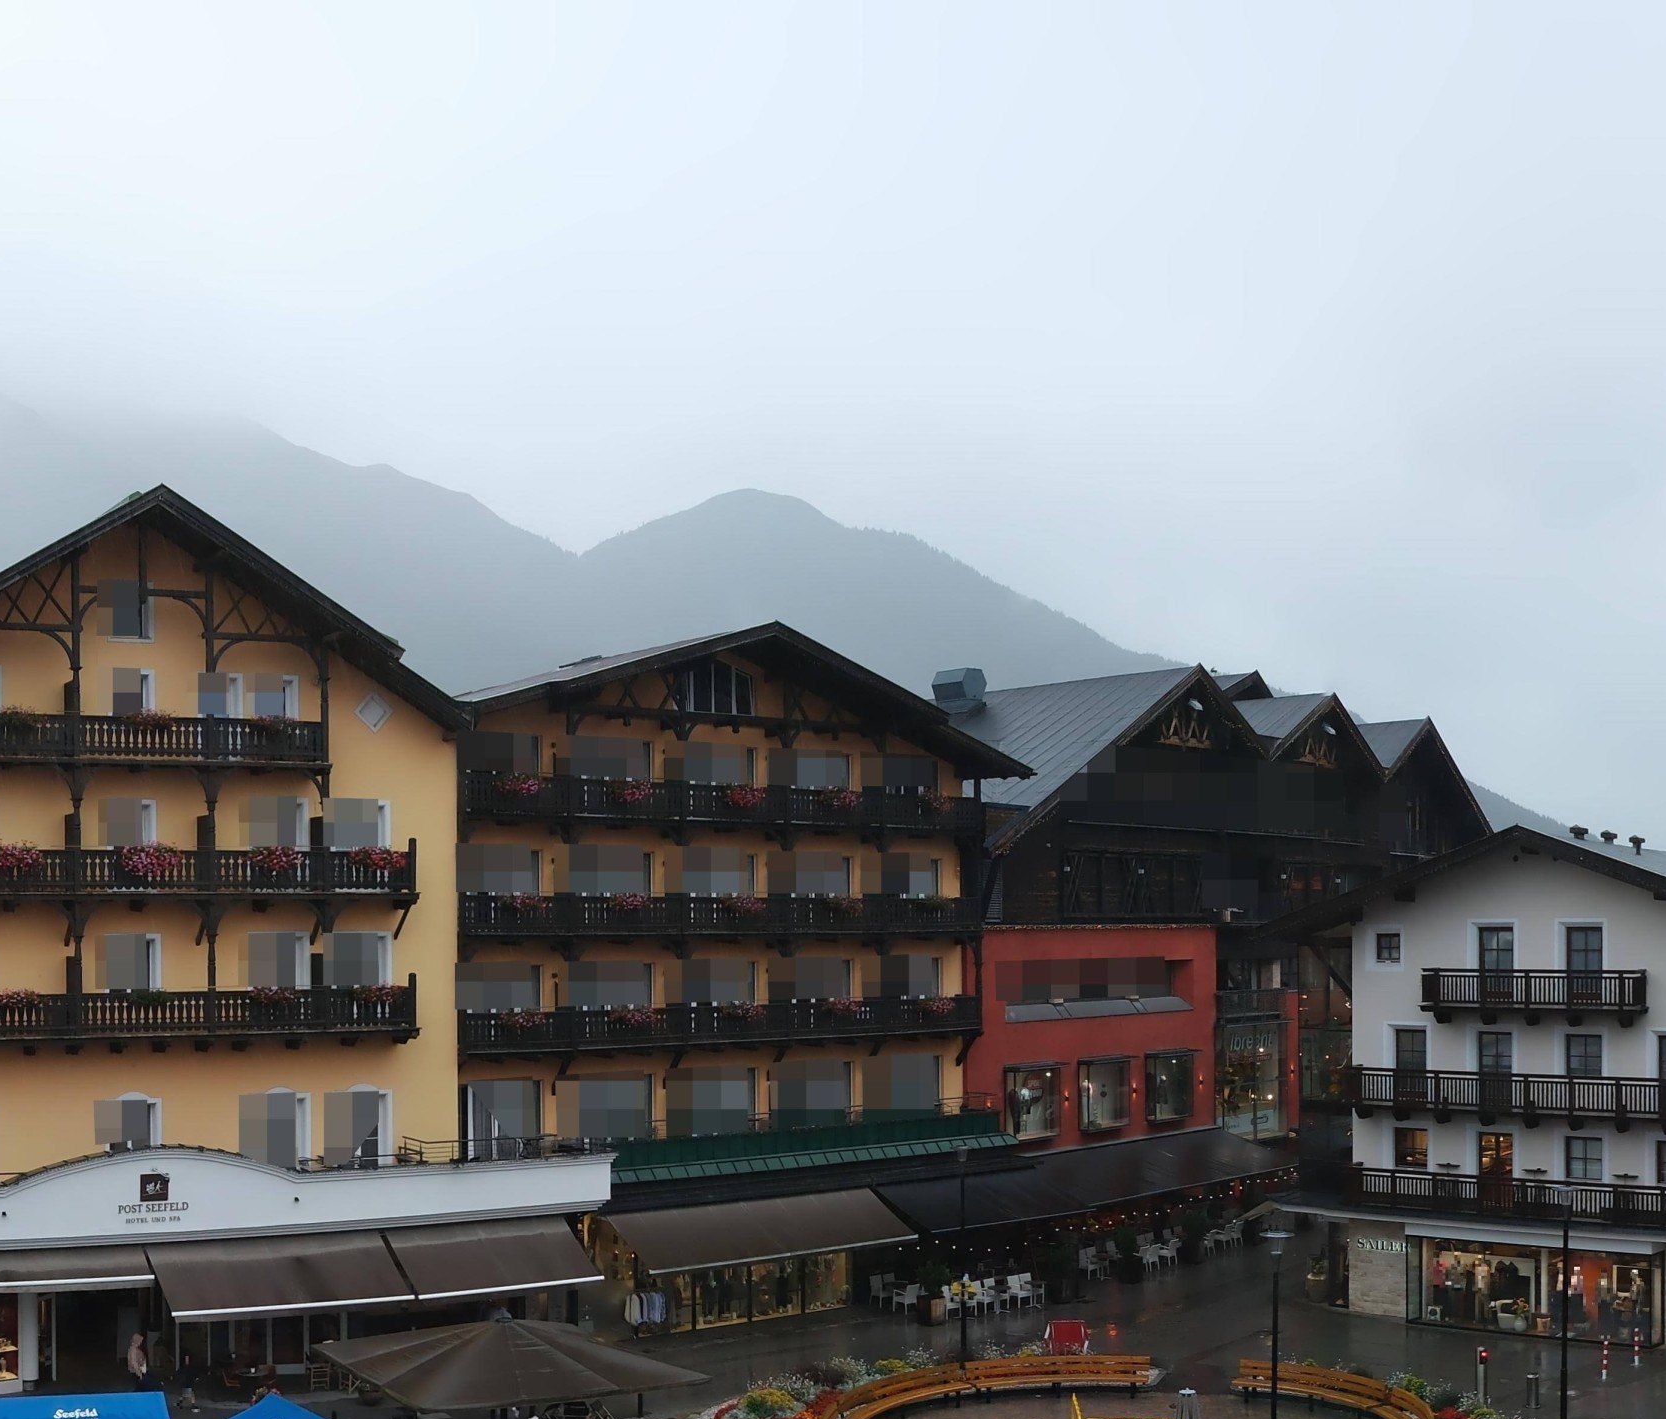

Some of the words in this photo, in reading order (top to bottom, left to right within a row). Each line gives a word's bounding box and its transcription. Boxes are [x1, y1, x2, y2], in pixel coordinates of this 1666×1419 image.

[118, 1204, 143, 1214] POST
[146, 1202, 189, 1213] SEEFELD
[1357, 1237, 1411, 1253] SAILER
[53, 1408, 99, 1419] Seefeld
